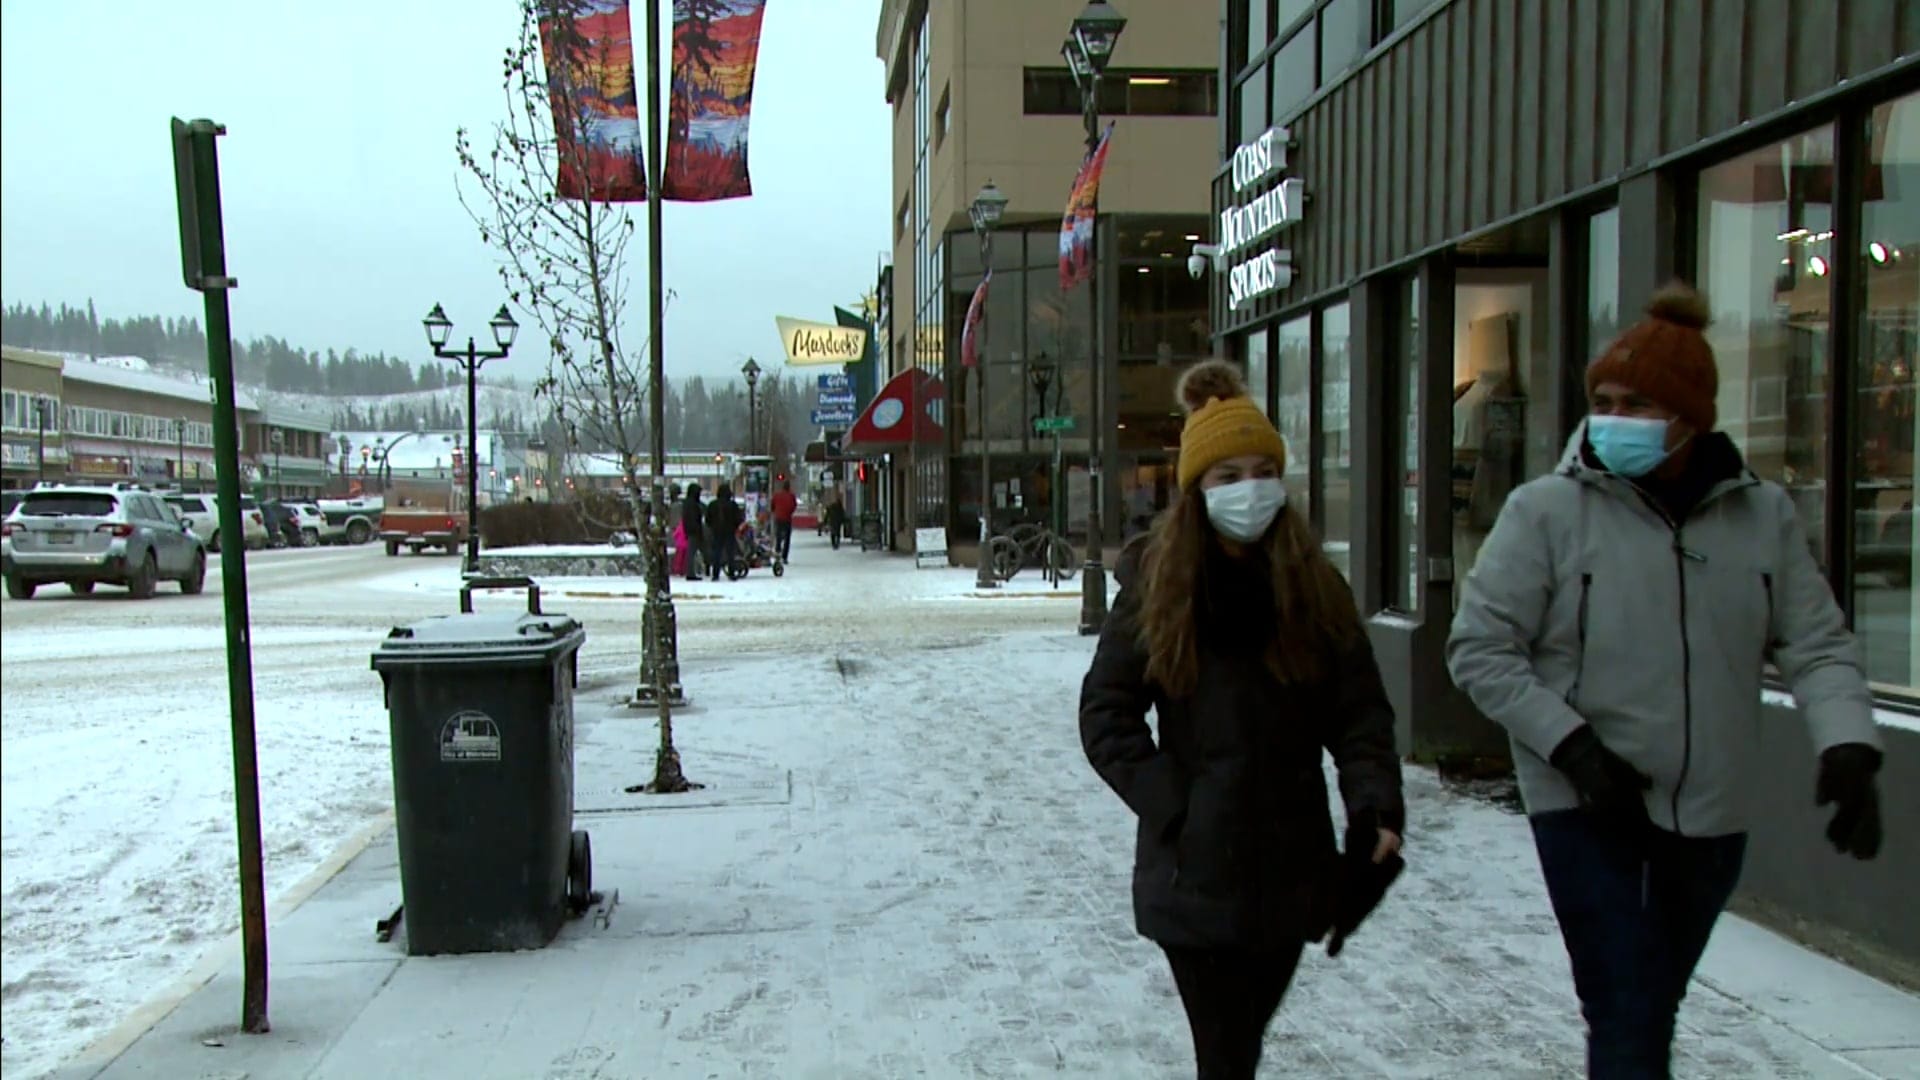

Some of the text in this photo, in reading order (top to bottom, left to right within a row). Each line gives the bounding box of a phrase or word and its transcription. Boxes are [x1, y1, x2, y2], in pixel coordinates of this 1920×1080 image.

[1232, 129, 1275, 193] COAST
[1219, 181, 1288, 257] MOUNTAIN
[1229, 248, 1276, 311] SPORTS
